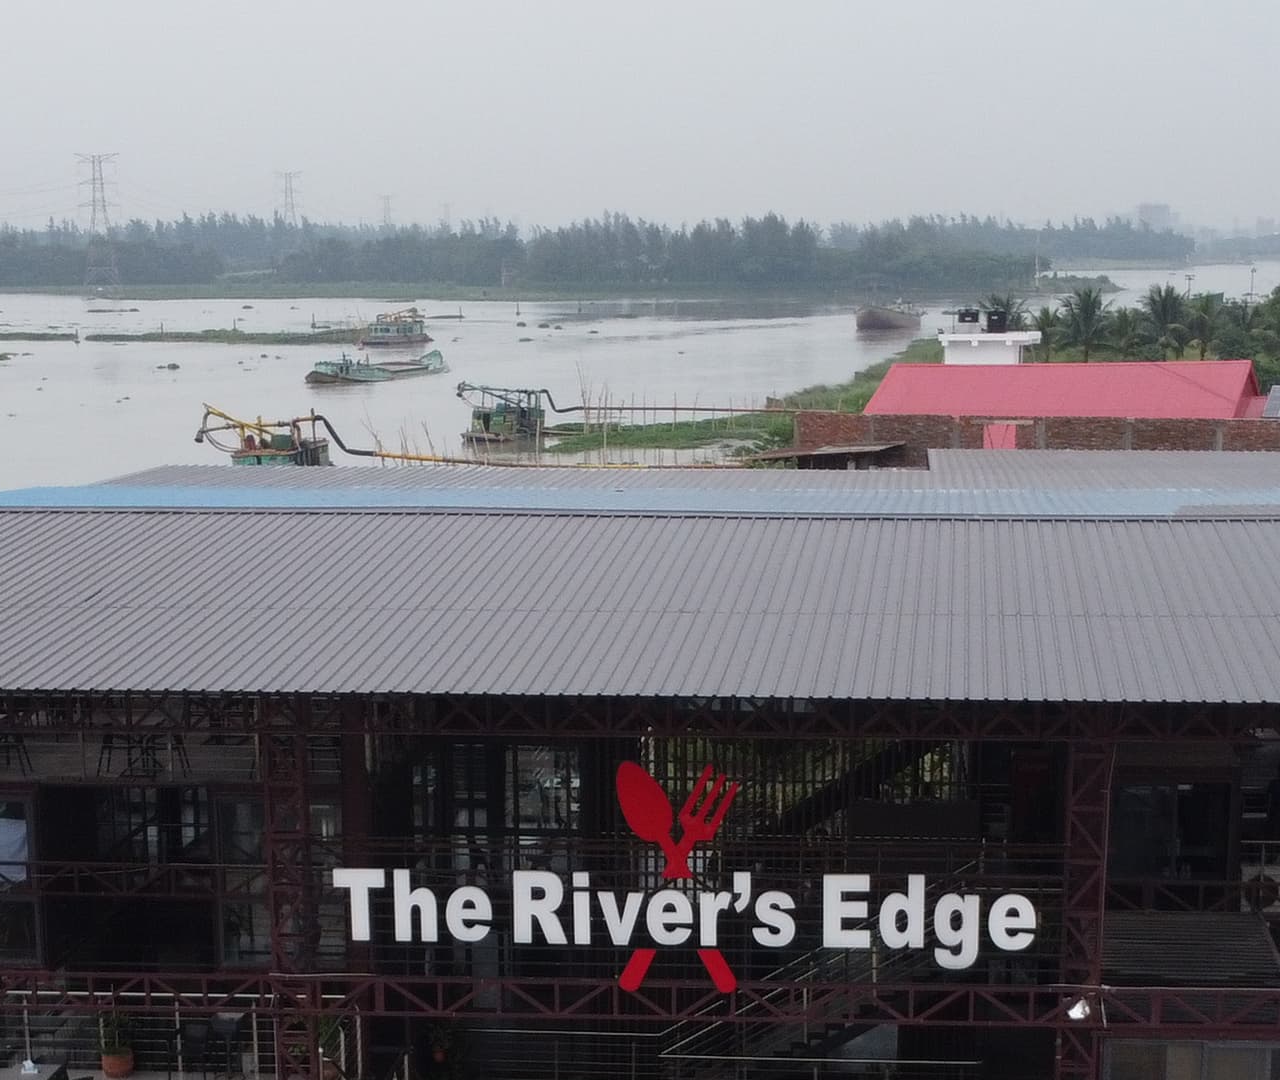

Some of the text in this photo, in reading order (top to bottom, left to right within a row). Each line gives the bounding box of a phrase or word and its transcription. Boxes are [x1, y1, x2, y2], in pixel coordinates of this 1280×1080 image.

[332, 868, 1037, 970] The River's Edge
